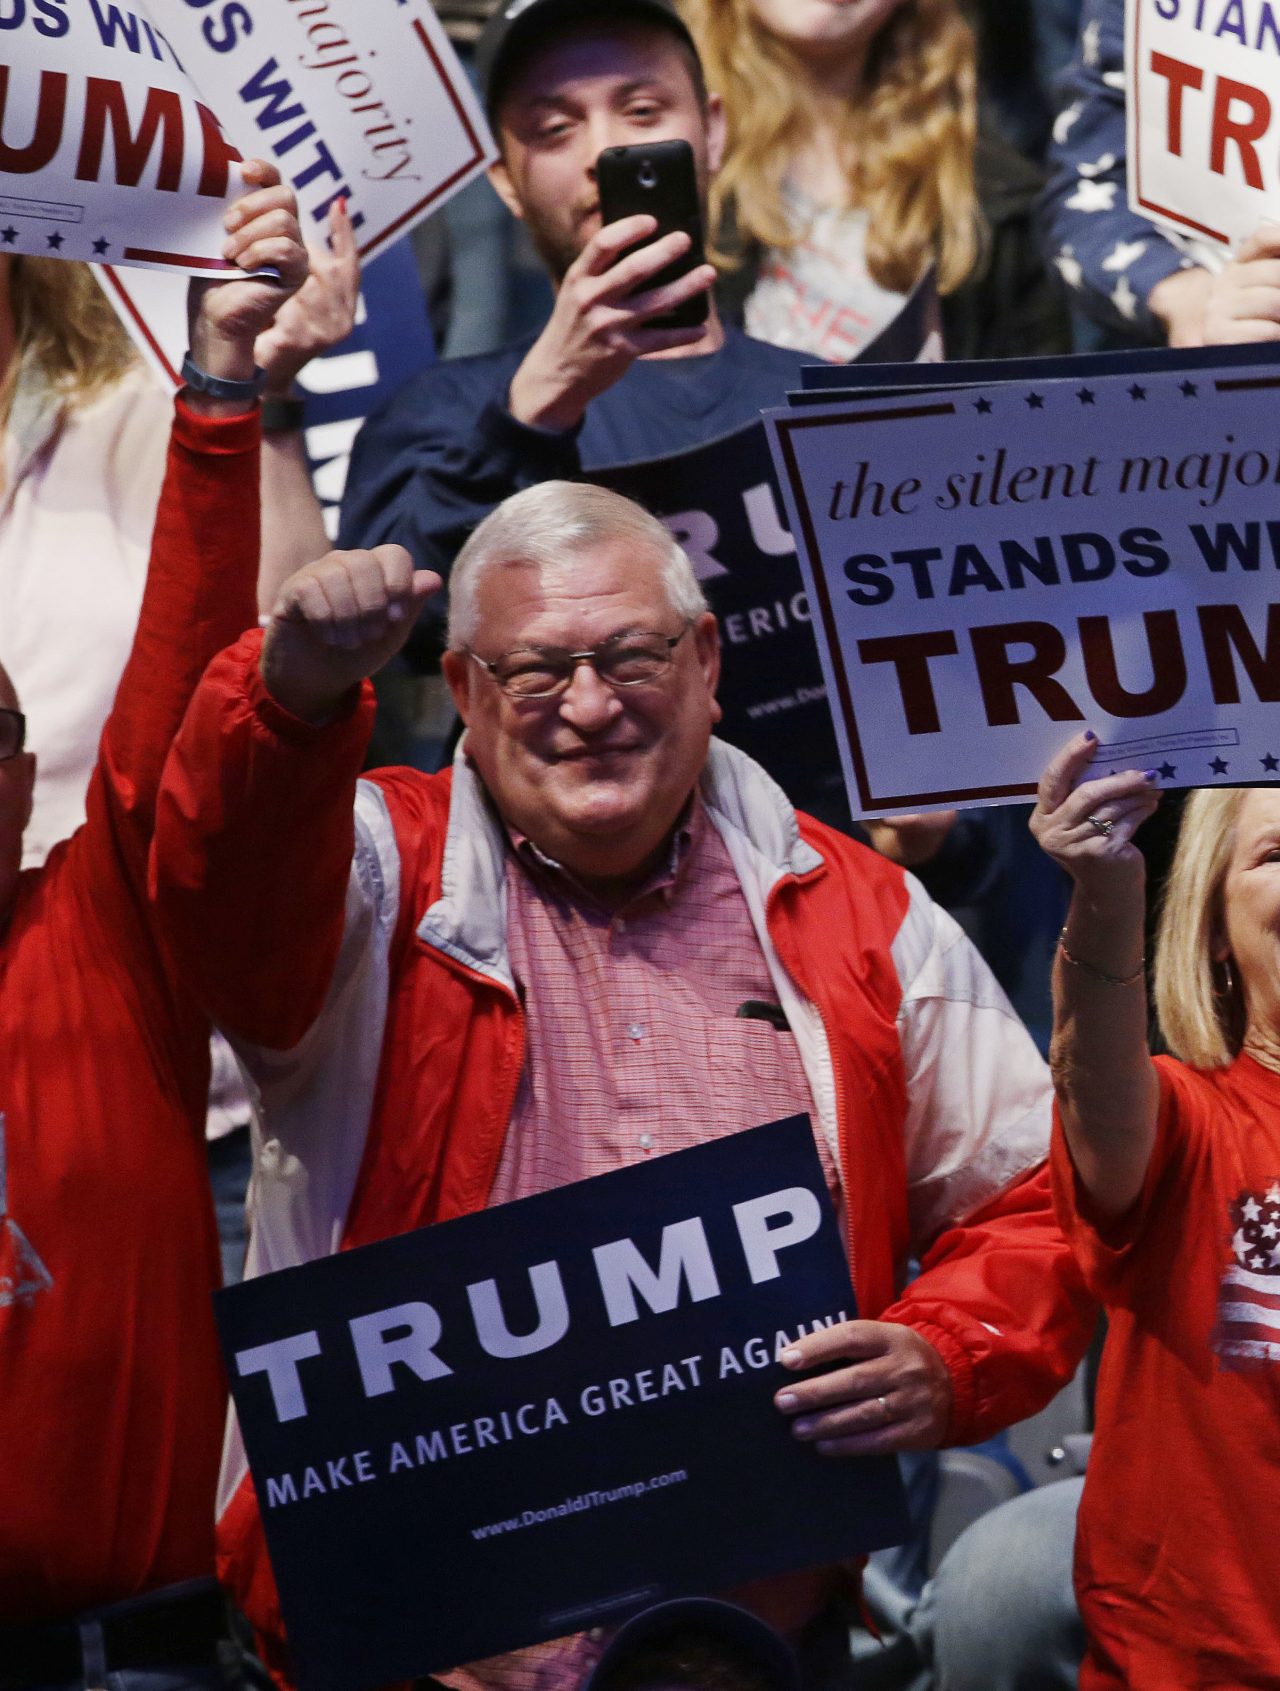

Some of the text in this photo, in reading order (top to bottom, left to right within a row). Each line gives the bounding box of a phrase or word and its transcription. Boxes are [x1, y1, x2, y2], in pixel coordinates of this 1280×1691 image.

[829, 460, 922, 521] the
[934, 448, 1102, 510] silent
[842, 527, 1171, 607] STANDS
[234, 1186, 823, 1424] TRUMP
[265, 1450, 375, 1508] MAKE
[388, 1398, 568, 1475] AMERICA
[580, 1355, 704, 1418] GREAT
[471, 1466, 688, 1541] www.DonaldJTrump.com
